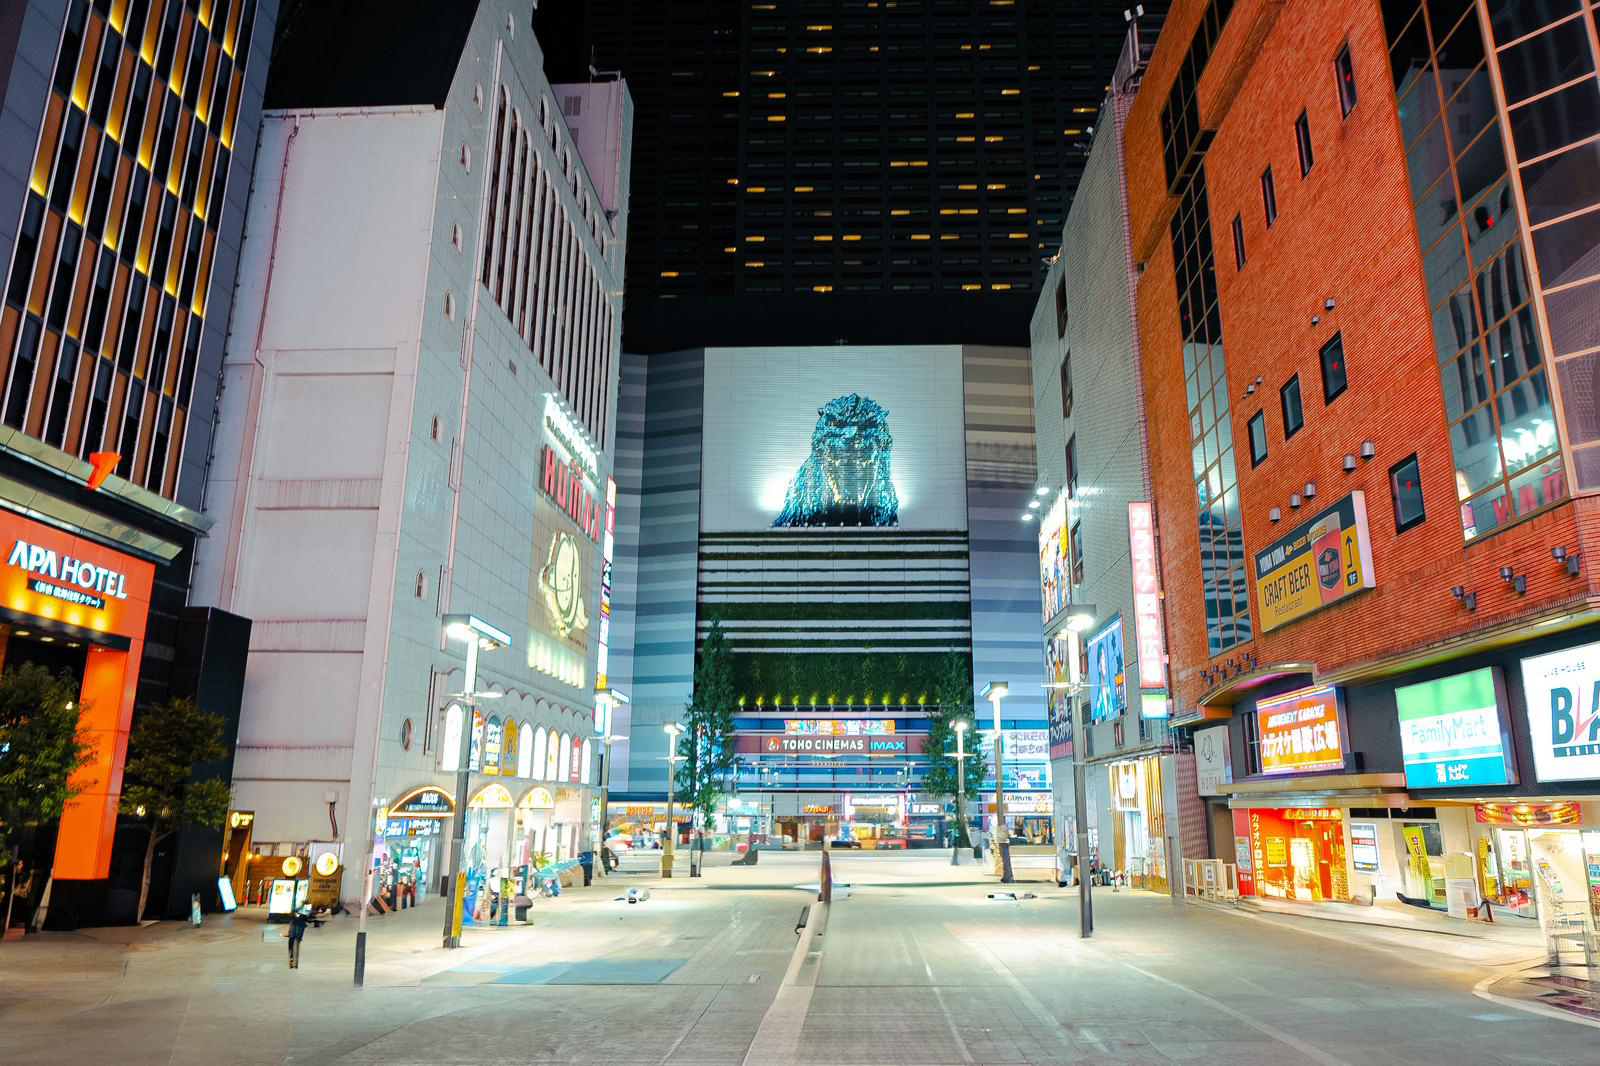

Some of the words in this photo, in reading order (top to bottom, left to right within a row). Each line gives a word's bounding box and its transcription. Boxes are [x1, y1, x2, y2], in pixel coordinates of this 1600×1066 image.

[8, 540, 58, 578] APA
[60, 556, 128, 599] HOTEL
[1264, 575, 1287, 608] CRAFT
[1289, 563, 1311, 595] BEER
[783, 739, 813, 750] TOHO
[815, 739, 864, 750] CINEMAS
[870, 741, 905, 751] IMAX
[1411, 715, 1487, 746] FamilyMart
[1435, 763, 1447, 783] 酒
